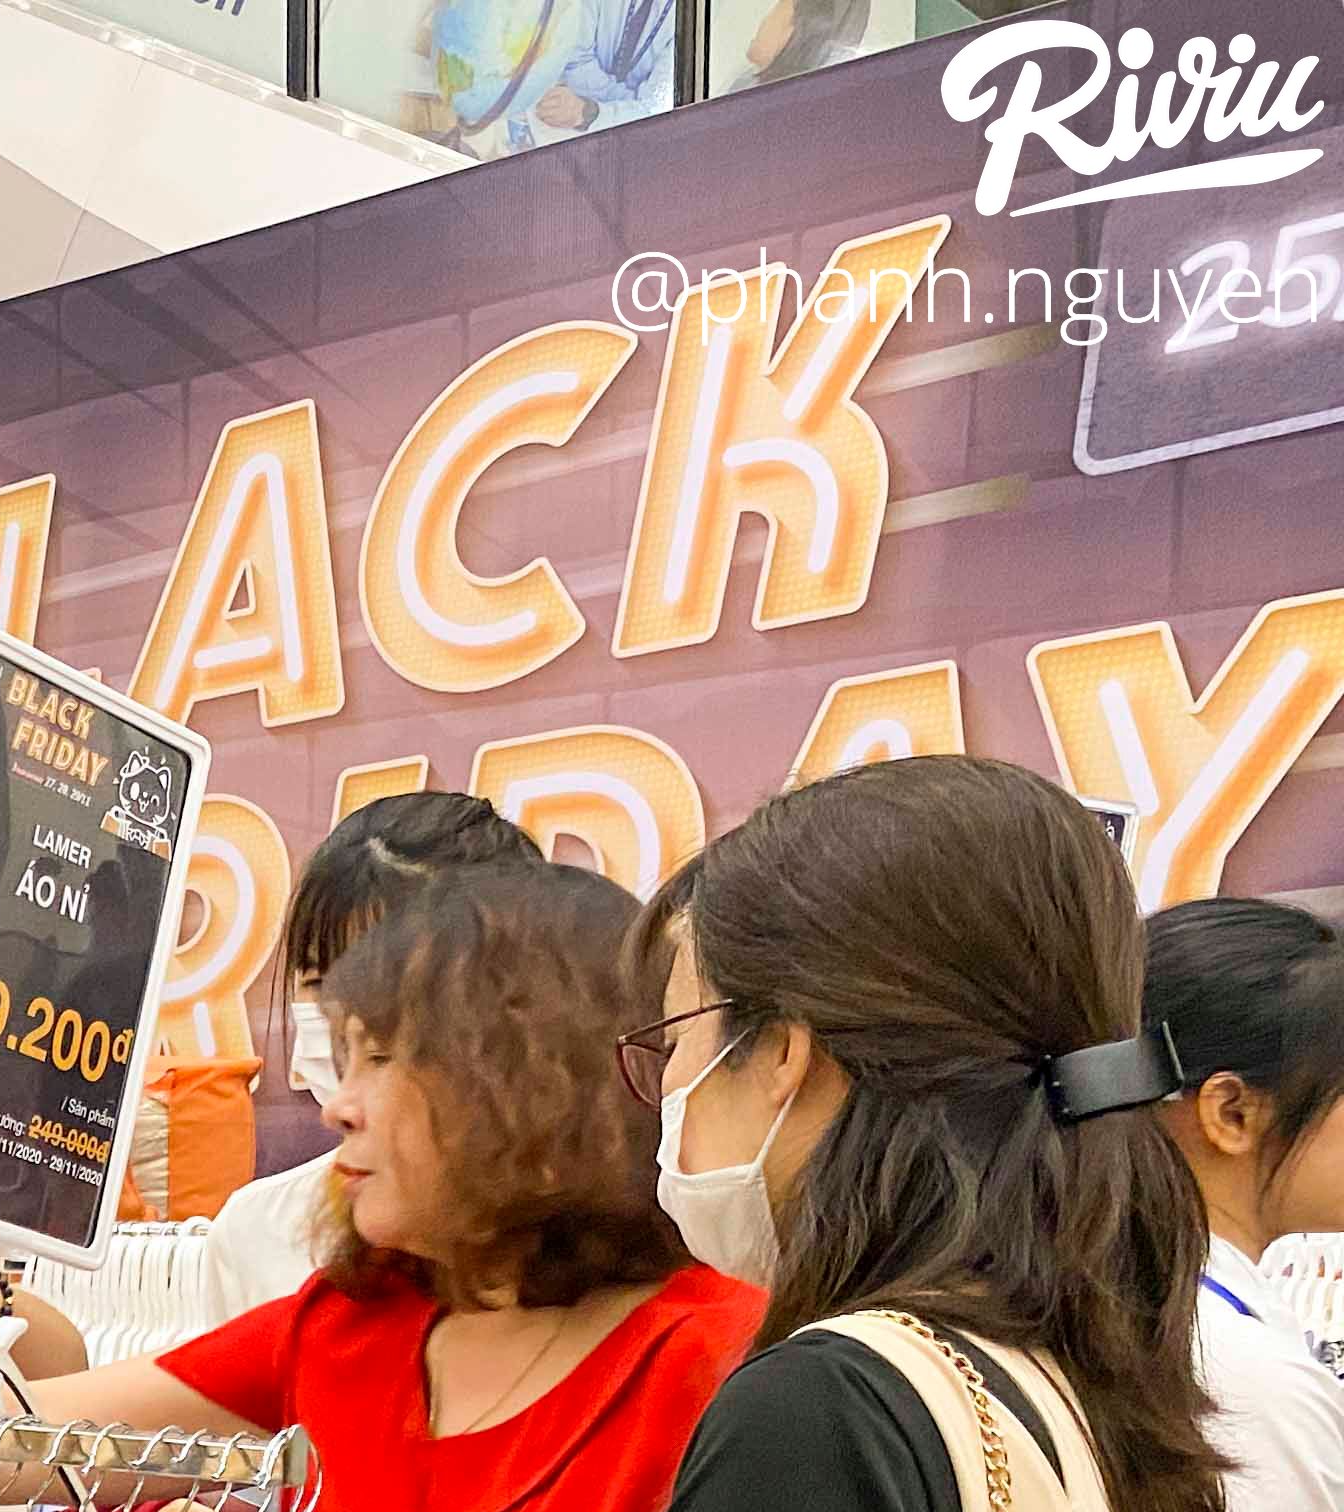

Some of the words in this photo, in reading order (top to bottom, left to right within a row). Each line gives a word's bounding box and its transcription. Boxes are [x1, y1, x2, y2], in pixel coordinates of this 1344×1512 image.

[6, 670, 97, 740] BLACK
[11, 718, 110, 788] FRIDAY
[32, 823, 92, 870] LAMER
[15, 859, 56, 909] ÁO
[59, 883, 91, 924] NỈ
[49, 1154, 104, 1187] 29/11/2020
